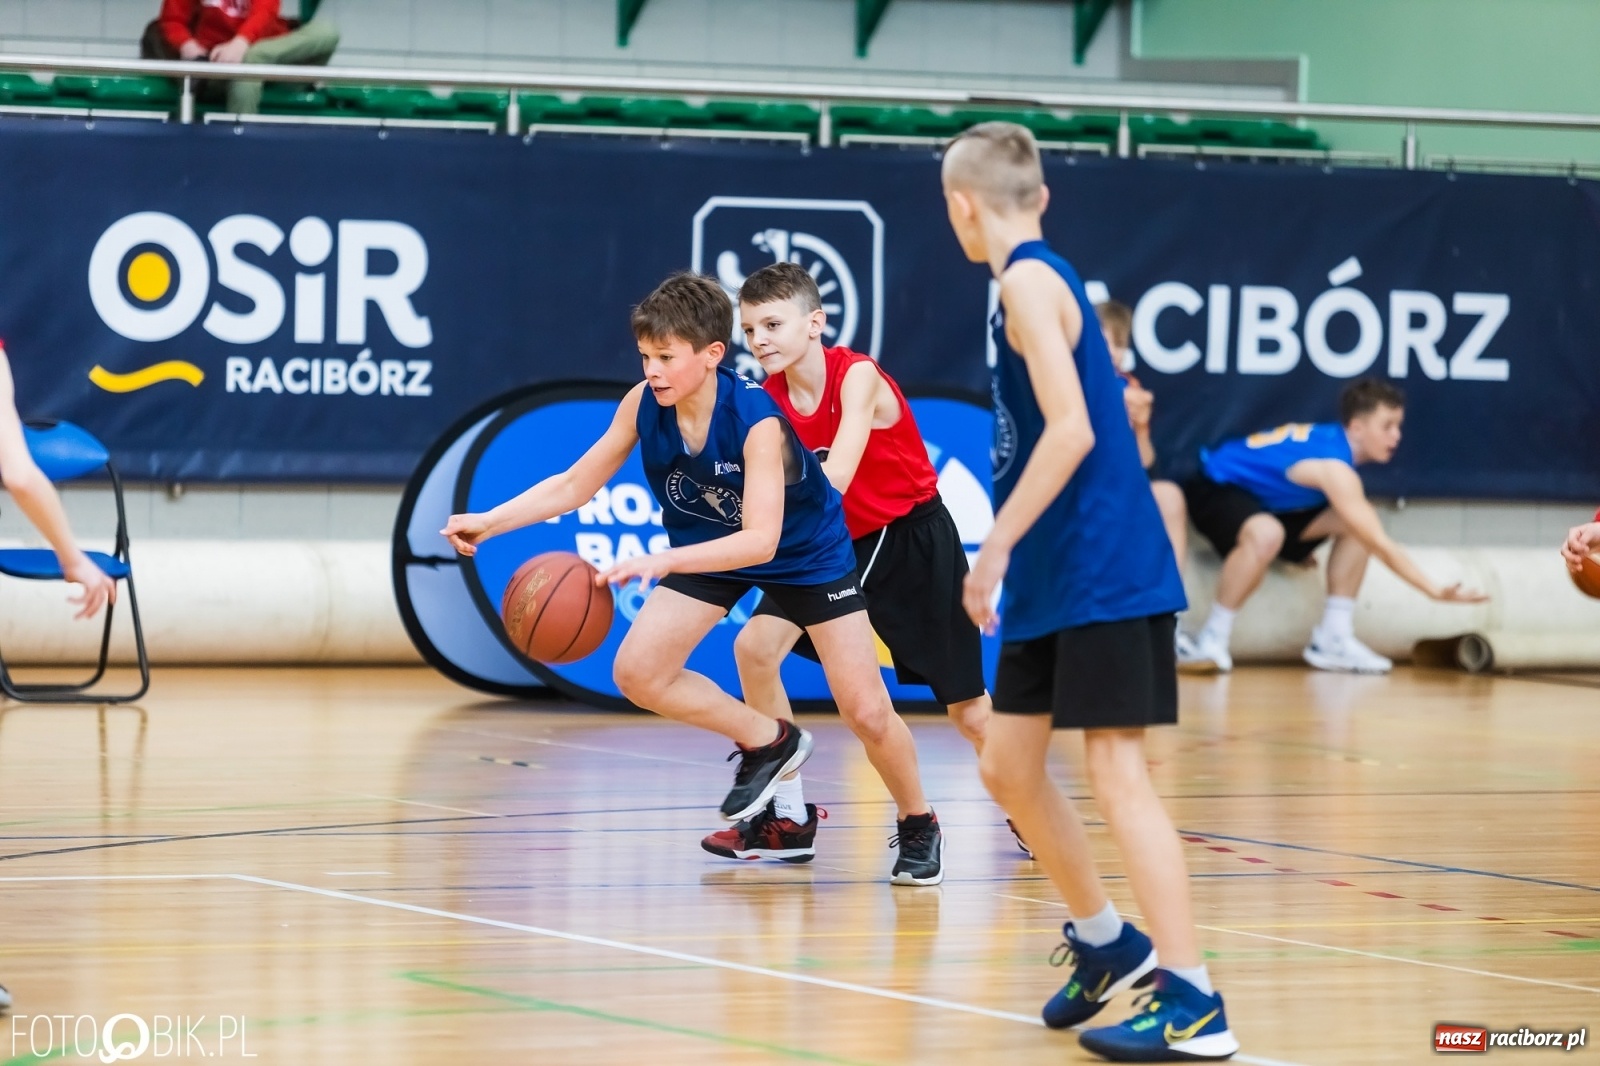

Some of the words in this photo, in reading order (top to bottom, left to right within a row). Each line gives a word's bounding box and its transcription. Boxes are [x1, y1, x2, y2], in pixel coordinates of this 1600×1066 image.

[986, 256, 1511, 382] CIBÓRZ
[225, 348, 433, 397] RACIBÓRZ
[827, 585, 858, 602] hummel
